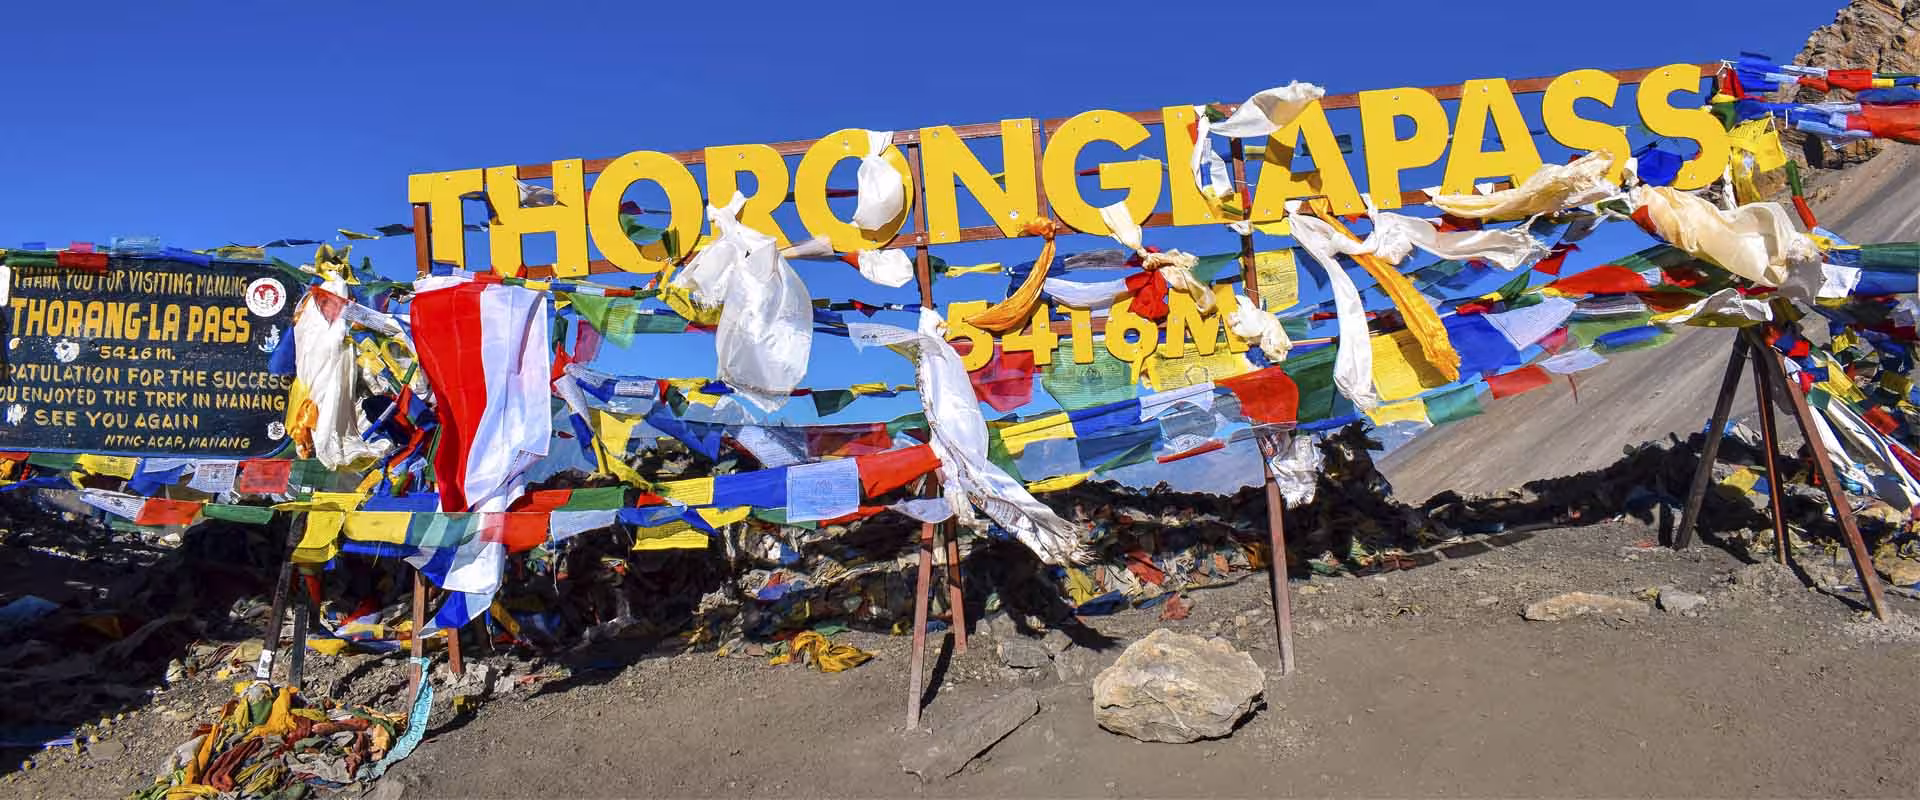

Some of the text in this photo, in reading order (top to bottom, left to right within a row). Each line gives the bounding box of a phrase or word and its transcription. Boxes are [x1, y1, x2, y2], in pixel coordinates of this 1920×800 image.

[13, 266, 248, 297] THANK YOU FOR VISITING MANANG
[11, 297, 250, 343] THORANG-LA PASS
[127, 367, 165, 388] FOR
[170, 369, 207, 387] THE
[212, 371, 292, 391] SUCCESS
[22, 386, 97, 406] ENJOYED
[103, 390, 137, 407] THE
[144, 391, 188, 409] TREK
[192, 393, 210, 409] IN
[215, 394, 286, 412] MANANG
[34, 409, 199, 430] SEE YOU AGAIN
[188, 437, 251, 449] MANANG
